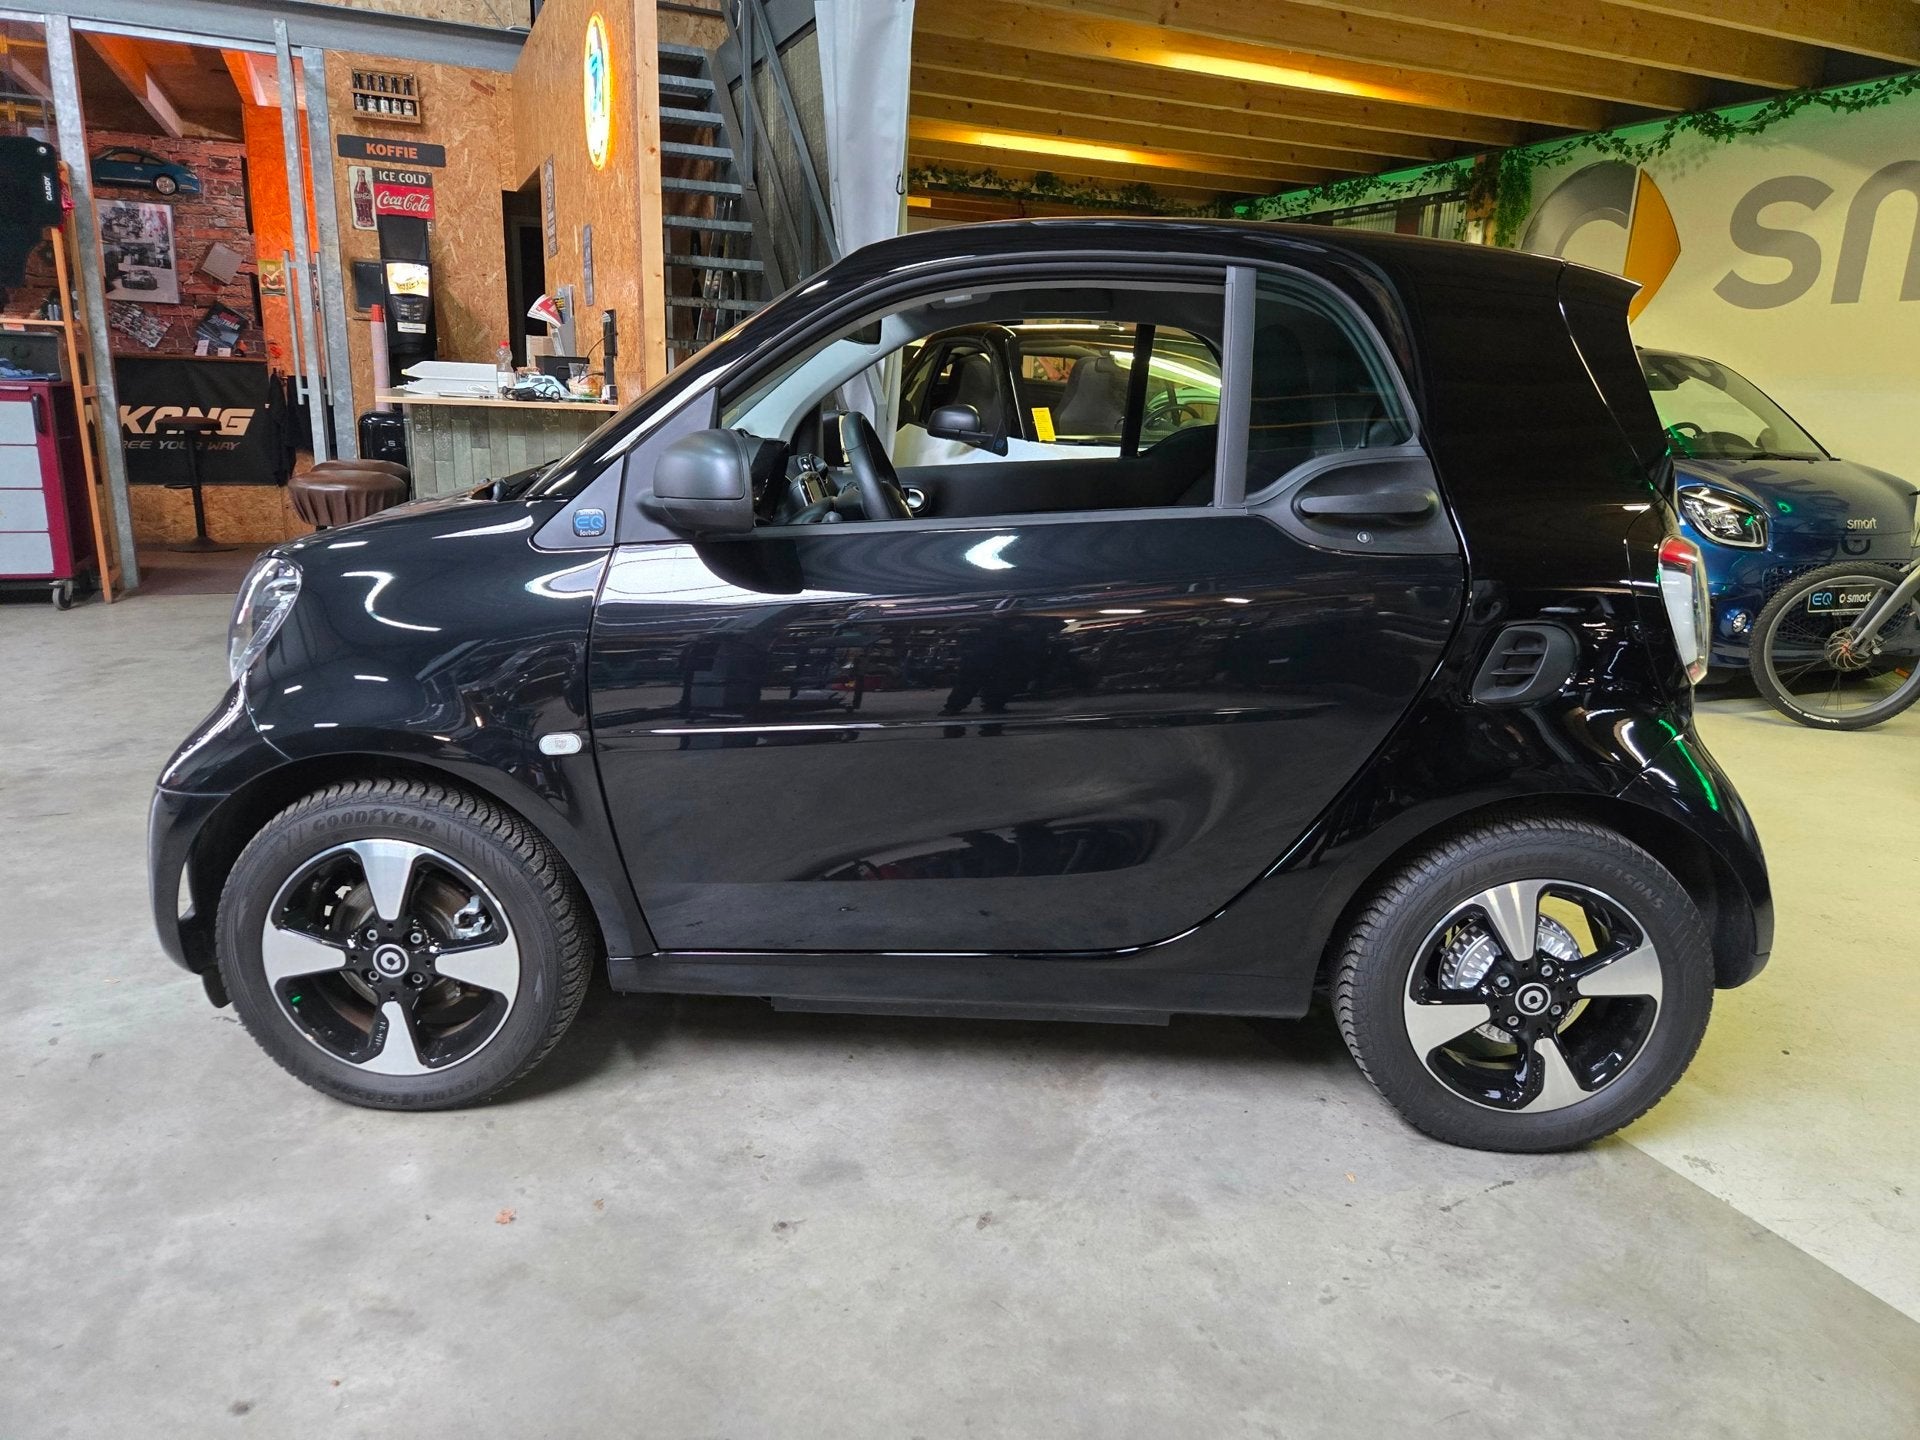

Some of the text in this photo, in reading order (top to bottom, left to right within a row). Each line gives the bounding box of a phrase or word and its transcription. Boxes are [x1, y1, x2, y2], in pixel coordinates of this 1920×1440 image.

[366, 143, 418, 159] KOFFIE
[378, 170, 427, 185] ICE COLD
[43, 175, 53, 201] CADDY
[575, 515, 604, 529] EQ
[1846, 517, 1877, 529] smart
[1811, 592, 1872, 606] EQ smart
